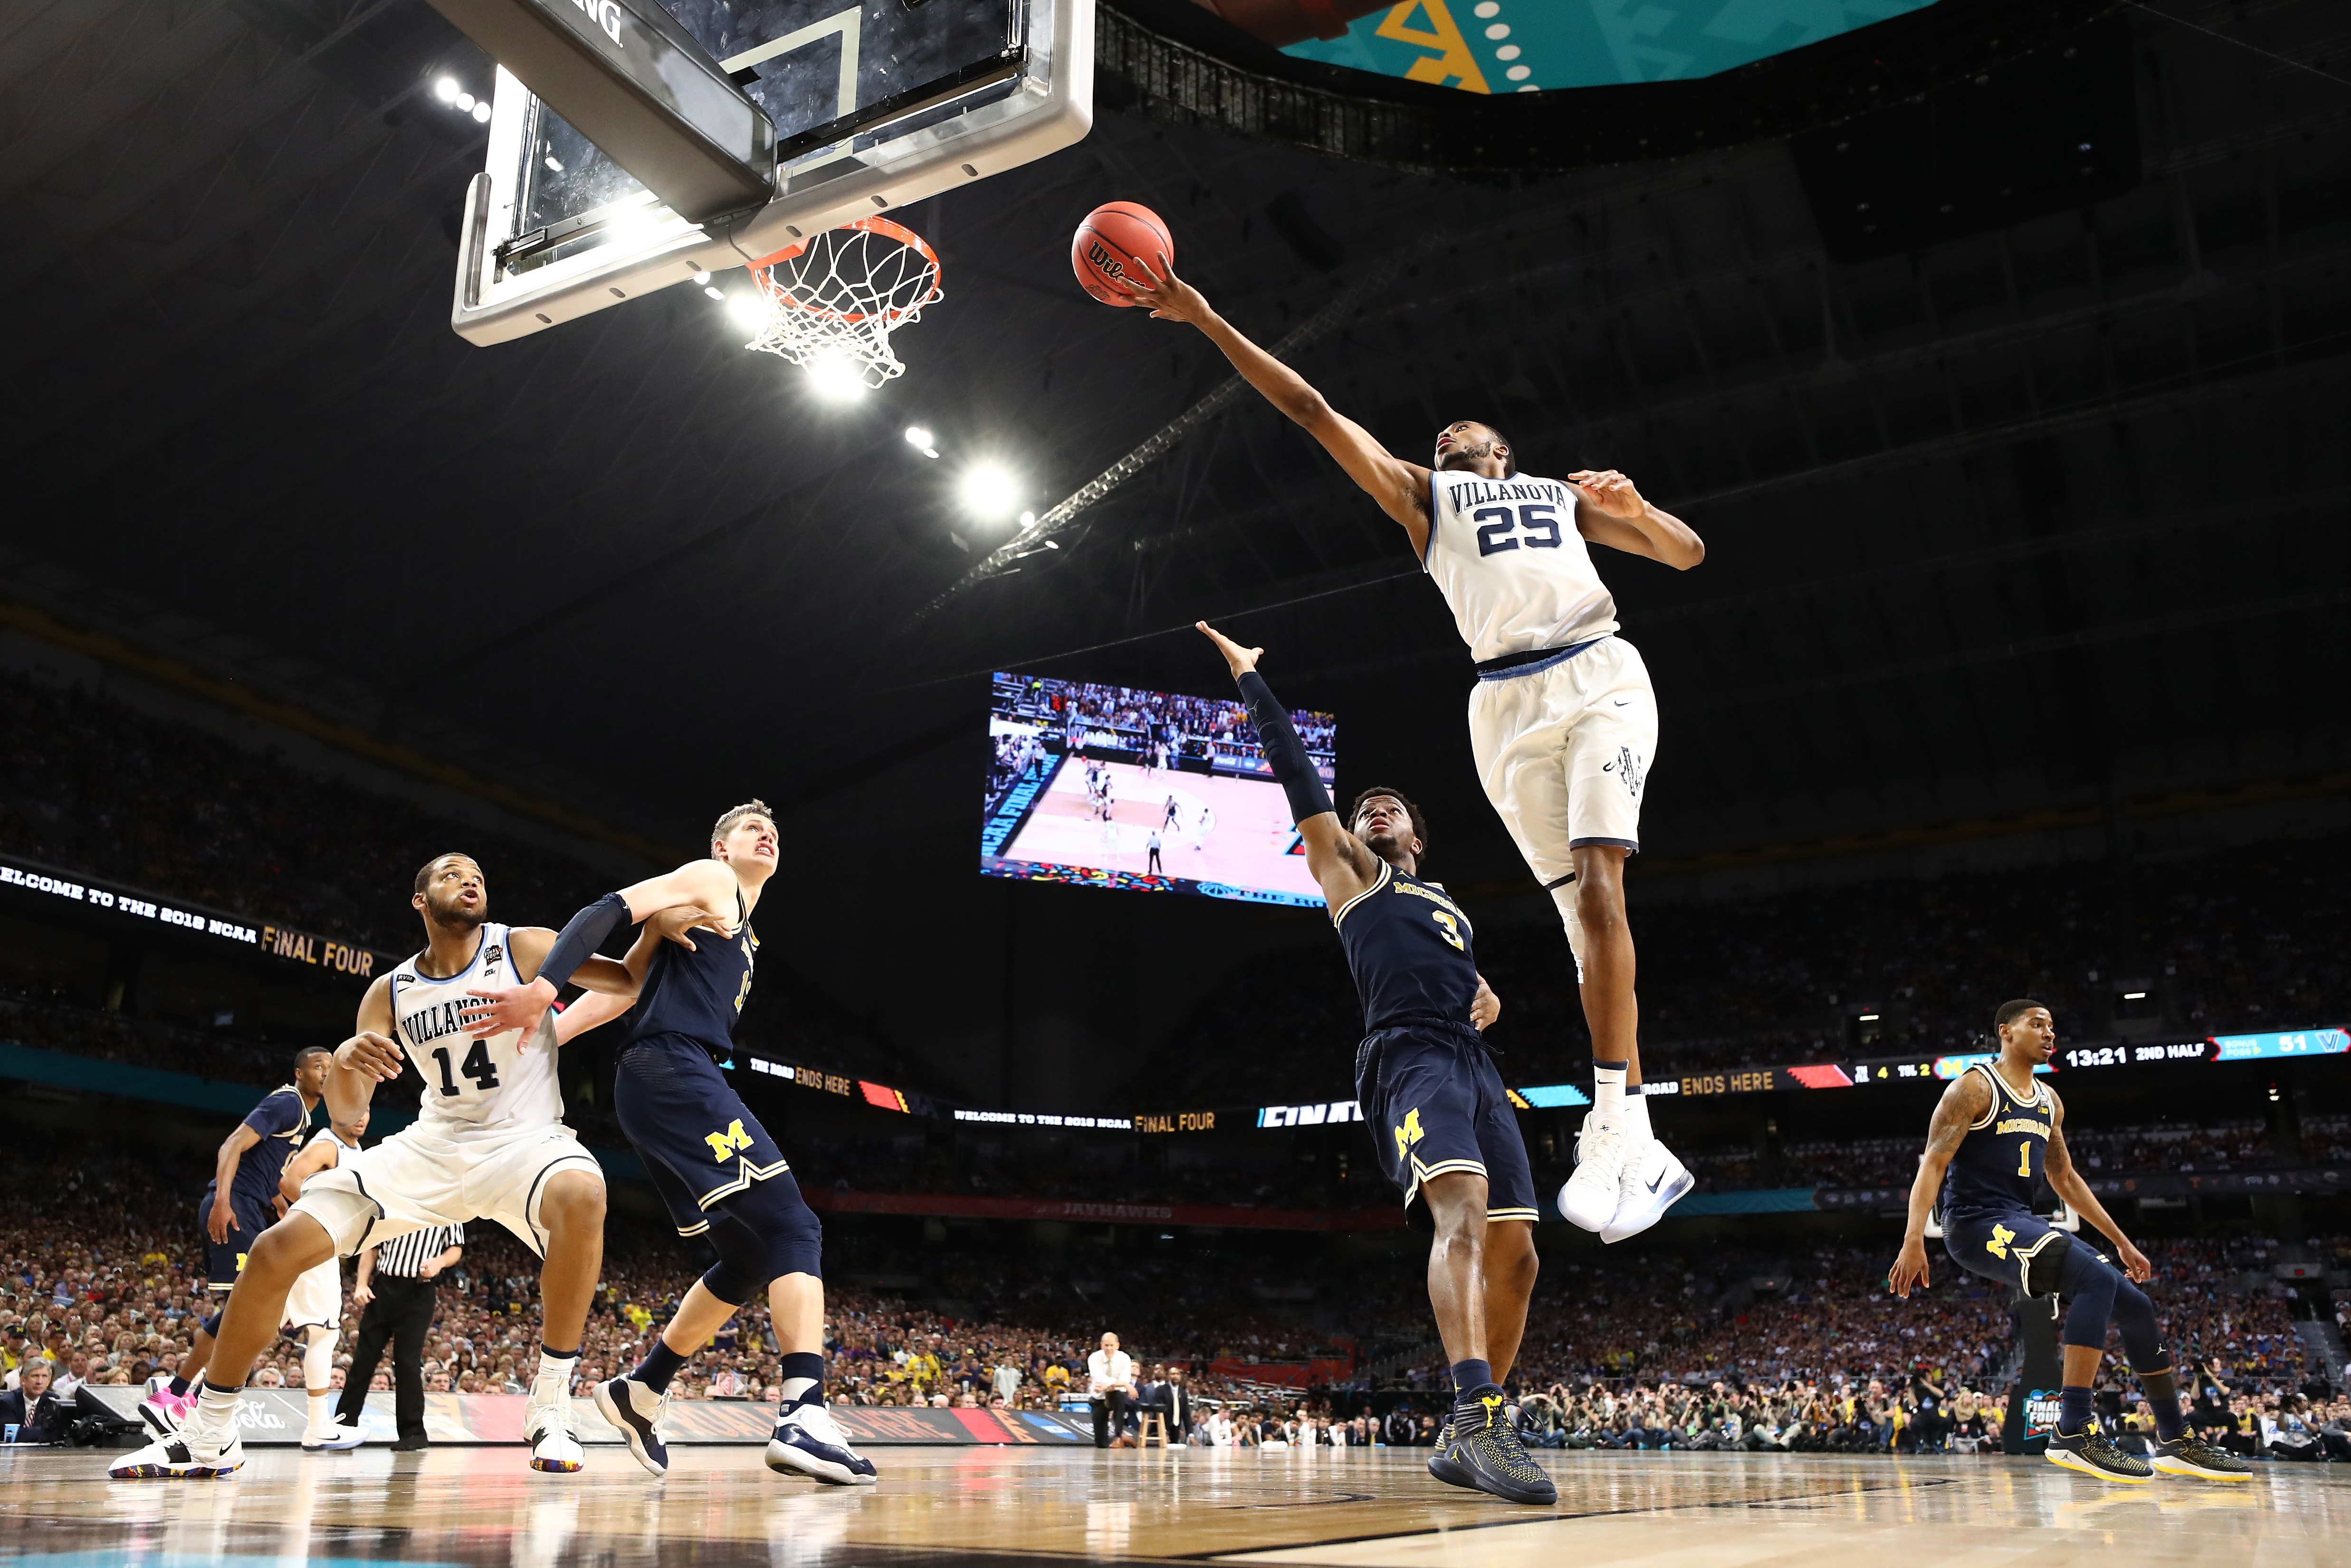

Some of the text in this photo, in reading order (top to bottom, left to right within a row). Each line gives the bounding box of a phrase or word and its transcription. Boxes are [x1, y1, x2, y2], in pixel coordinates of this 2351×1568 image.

[1088, 240, 1146, 288] Wil
[1448, 482, 1567, 516] VILLANOVA
[1473, 505, 1563, 557] 25
[0, 866, 374, 978] ELCOME TO THE 2018 NCAA FINAL FOUR
[1432, 909, 1464, 951] 3
[2065, 1043, 2205, 1067] 13:21 2ND HALF
[2279, 1034, 2307, 1052] 51
[431, 1039, 500, 1097] 14
[750, 1058, 851, 1097] THE ROAD ENDS HERE
[1877, 1066, 1889, 1079] 4
[1897, 1064, 1918, 1077] TOL
[1919, 1063, 1931, 1076] 2
[1644, 1071, 1775, 1096] ROAD ENDS HERE
[954, 1110, 1215, 1133] WELCOME TO THE 2018 NCAA FINAL FOUR
[1996, 1118, 2052, 1143] MICHIGAN
[705, 1118, 755, 1164] M
[2018, 1140, 2031, 1177] 1
[1064, 1202, 1173, 1219] JAYHAWKS
[232, 1401, 286, 1429] ola
[2026, 1400, 2061, 1414] FINAL
[2029, 1412, 2062, 1424] FOUR
